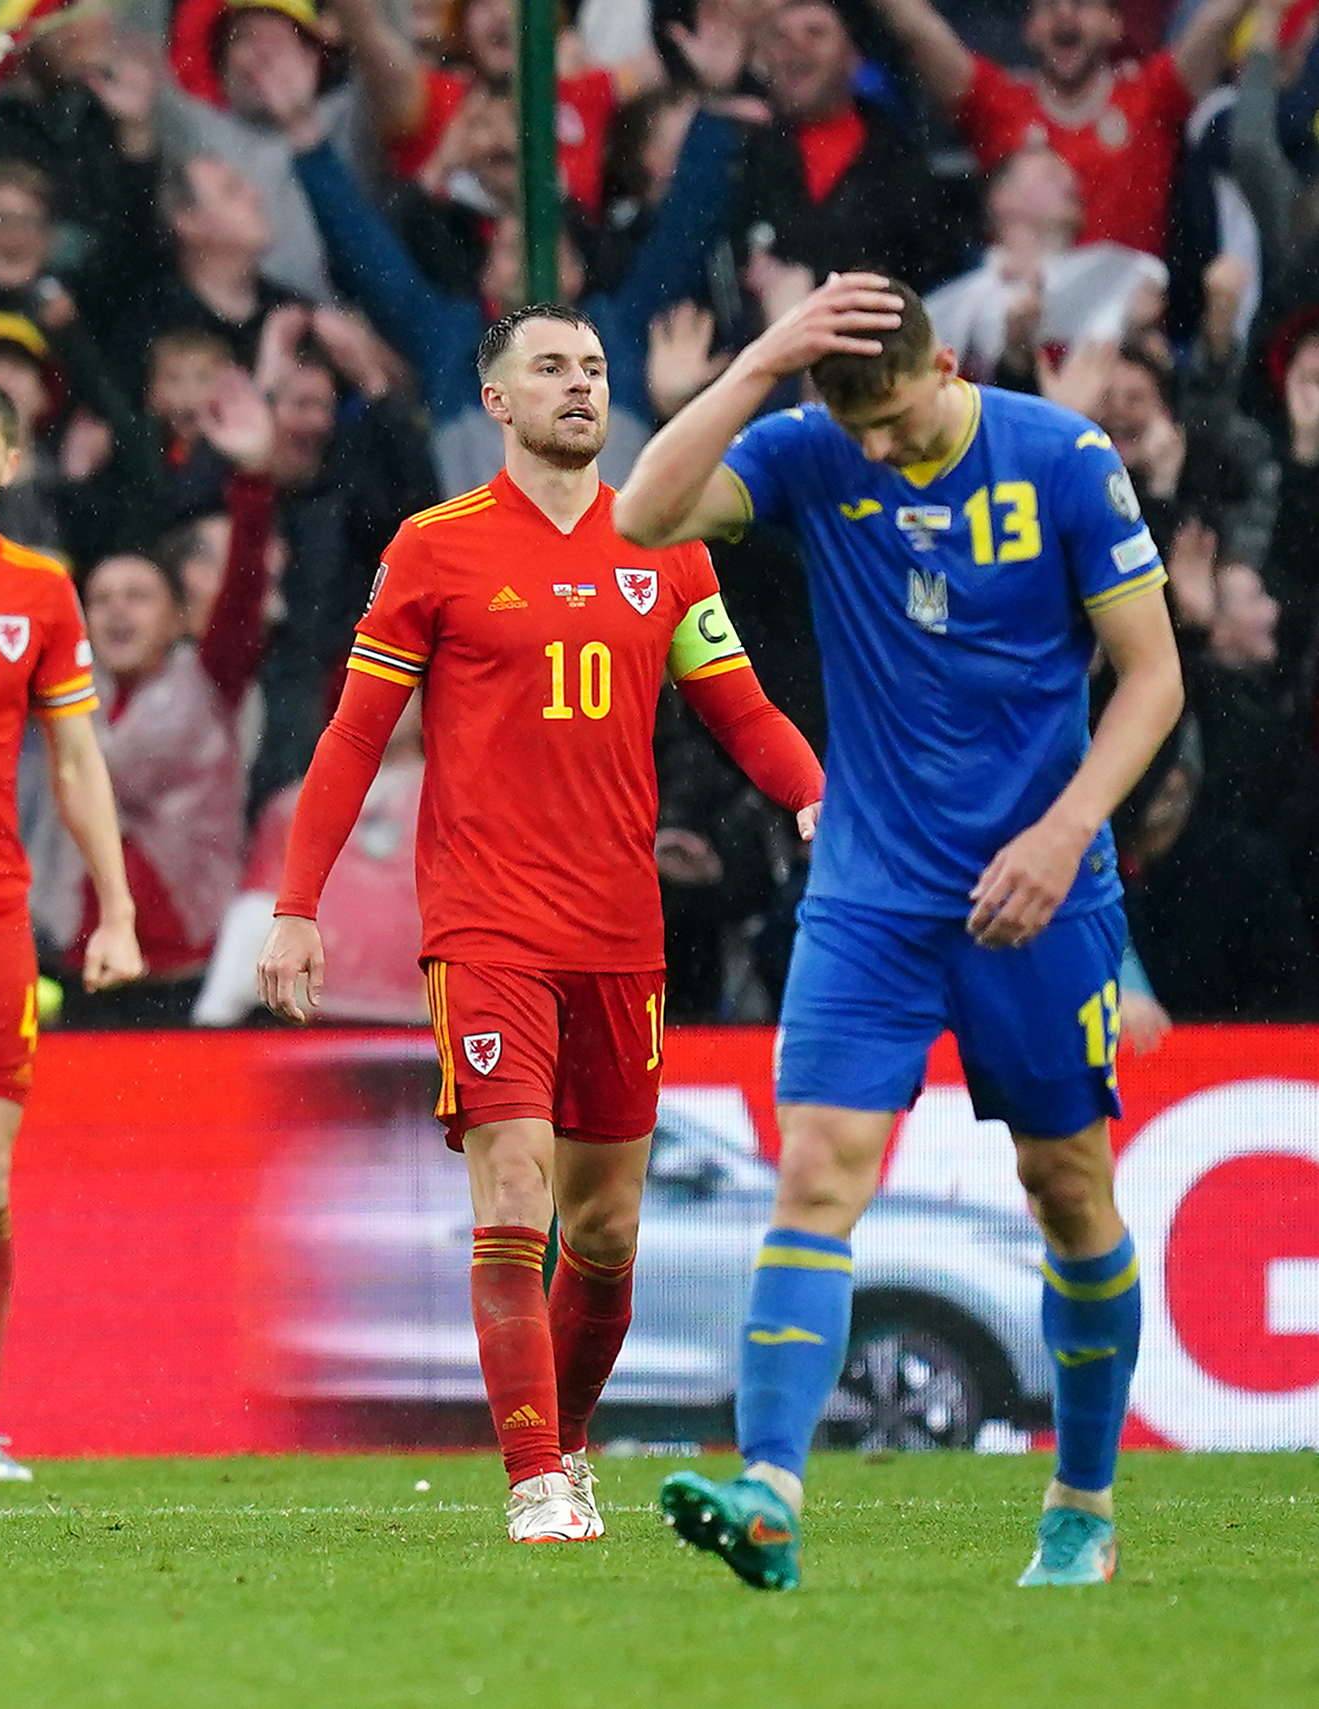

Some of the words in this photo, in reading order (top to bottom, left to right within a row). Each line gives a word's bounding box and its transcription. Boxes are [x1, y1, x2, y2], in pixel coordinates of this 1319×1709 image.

[963, 480, 1043, 566] 13
[698, 608, 728, 644] C
[542, 641, 612, 720] 10
[645, 983, 666, 1071] 1
